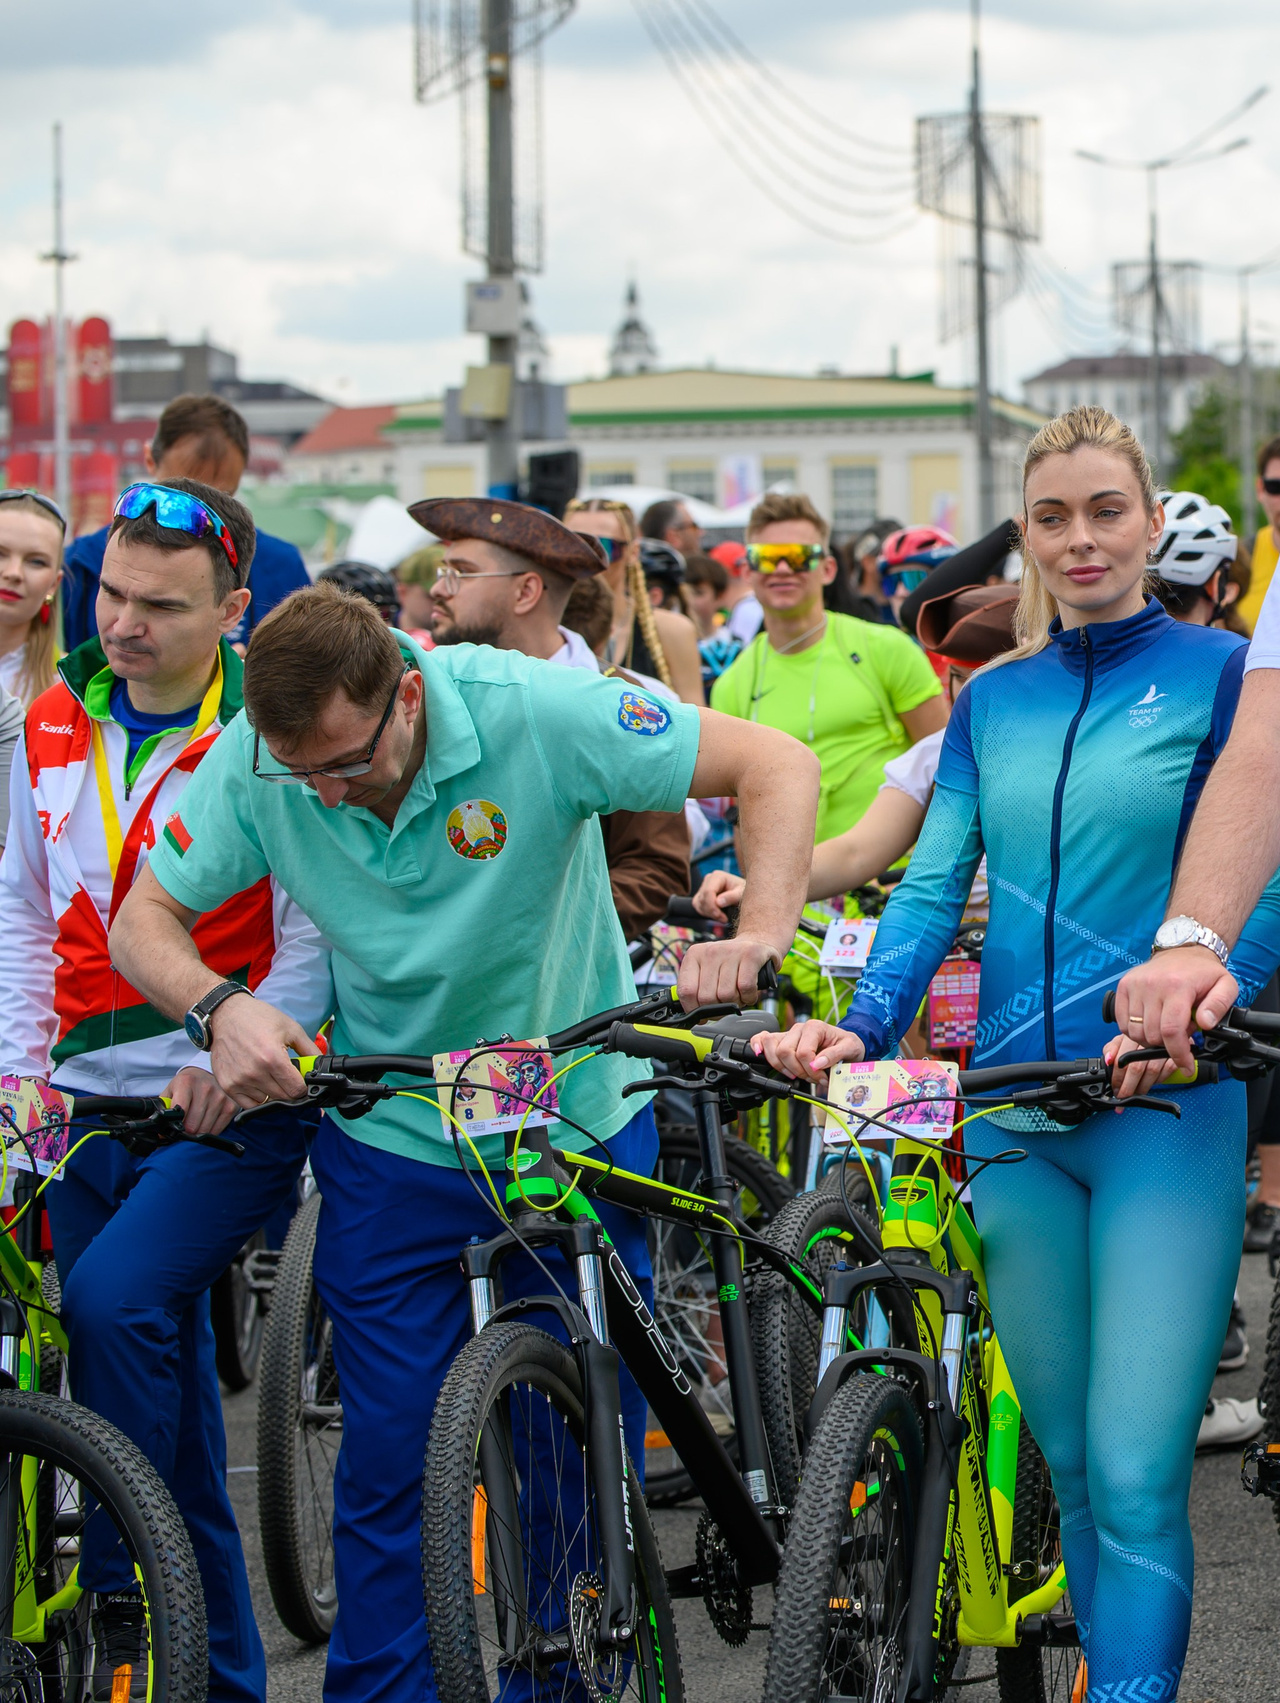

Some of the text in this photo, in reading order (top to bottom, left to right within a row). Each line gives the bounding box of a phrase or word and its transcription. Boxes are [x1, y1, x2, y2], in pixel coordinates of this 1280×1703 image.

[1128, 706, 1163, 716] TEAM BY
[948, 1005, 974, 1014] VIVA
[1, 1090, 17, 1099] VIVA
[464, 1107, 474, 1120] 8
[671, 1196, 705, 1213] SLIDE 3.0
[991, 1413, 1014, 1421] 27.5
